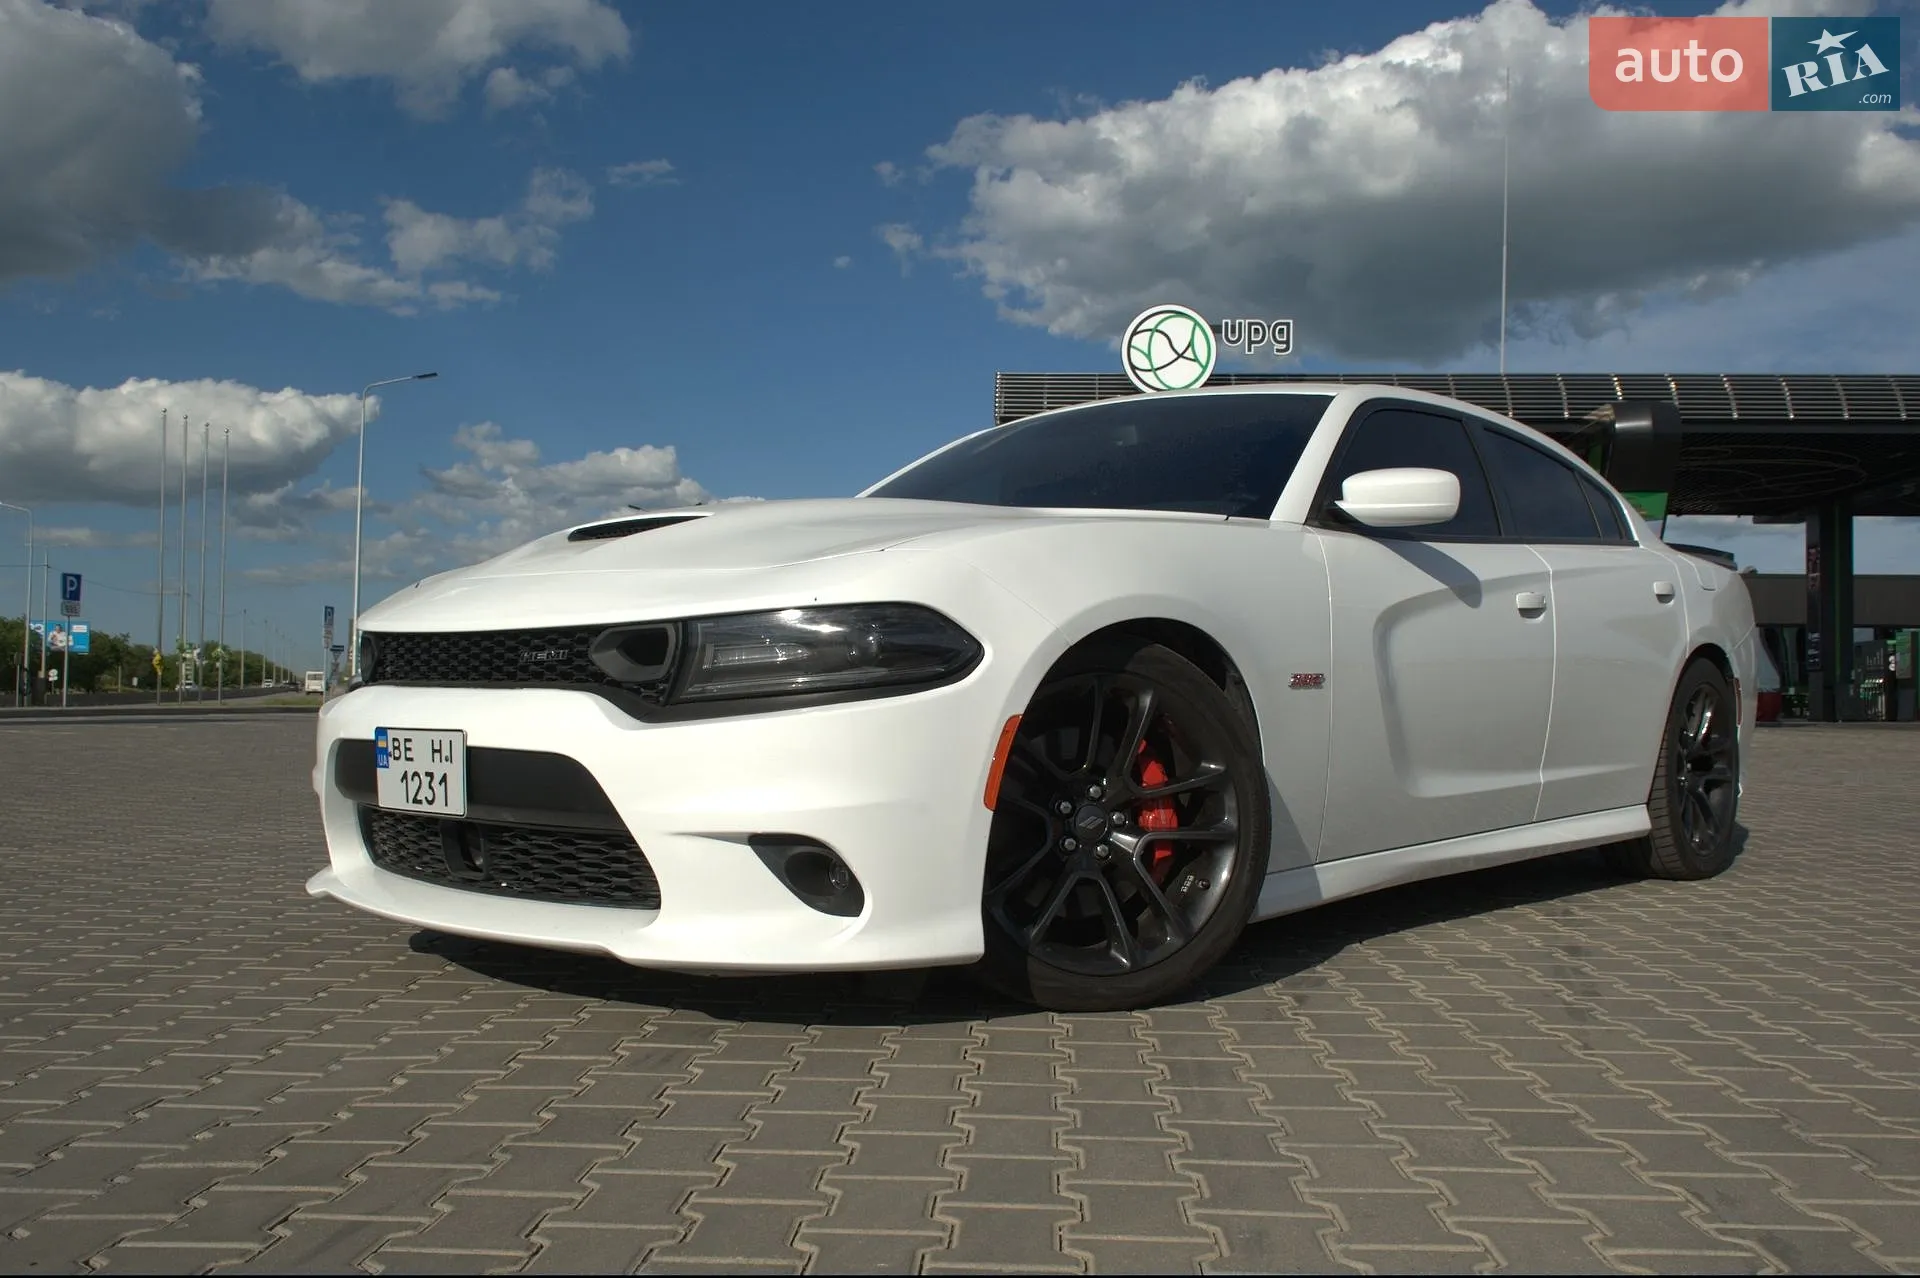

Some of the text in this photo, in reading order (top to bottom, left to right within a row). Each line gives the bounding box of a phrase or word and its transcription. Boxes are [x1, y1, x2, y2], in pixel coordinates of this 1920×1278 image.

[1222, 319, 1293, 355] upg
[66, 576, 78, 599] P
[377, 754, 389, 767] UA
[392, 737, 453, 763] BE HI
[400, 770, 448, 807] 1231
